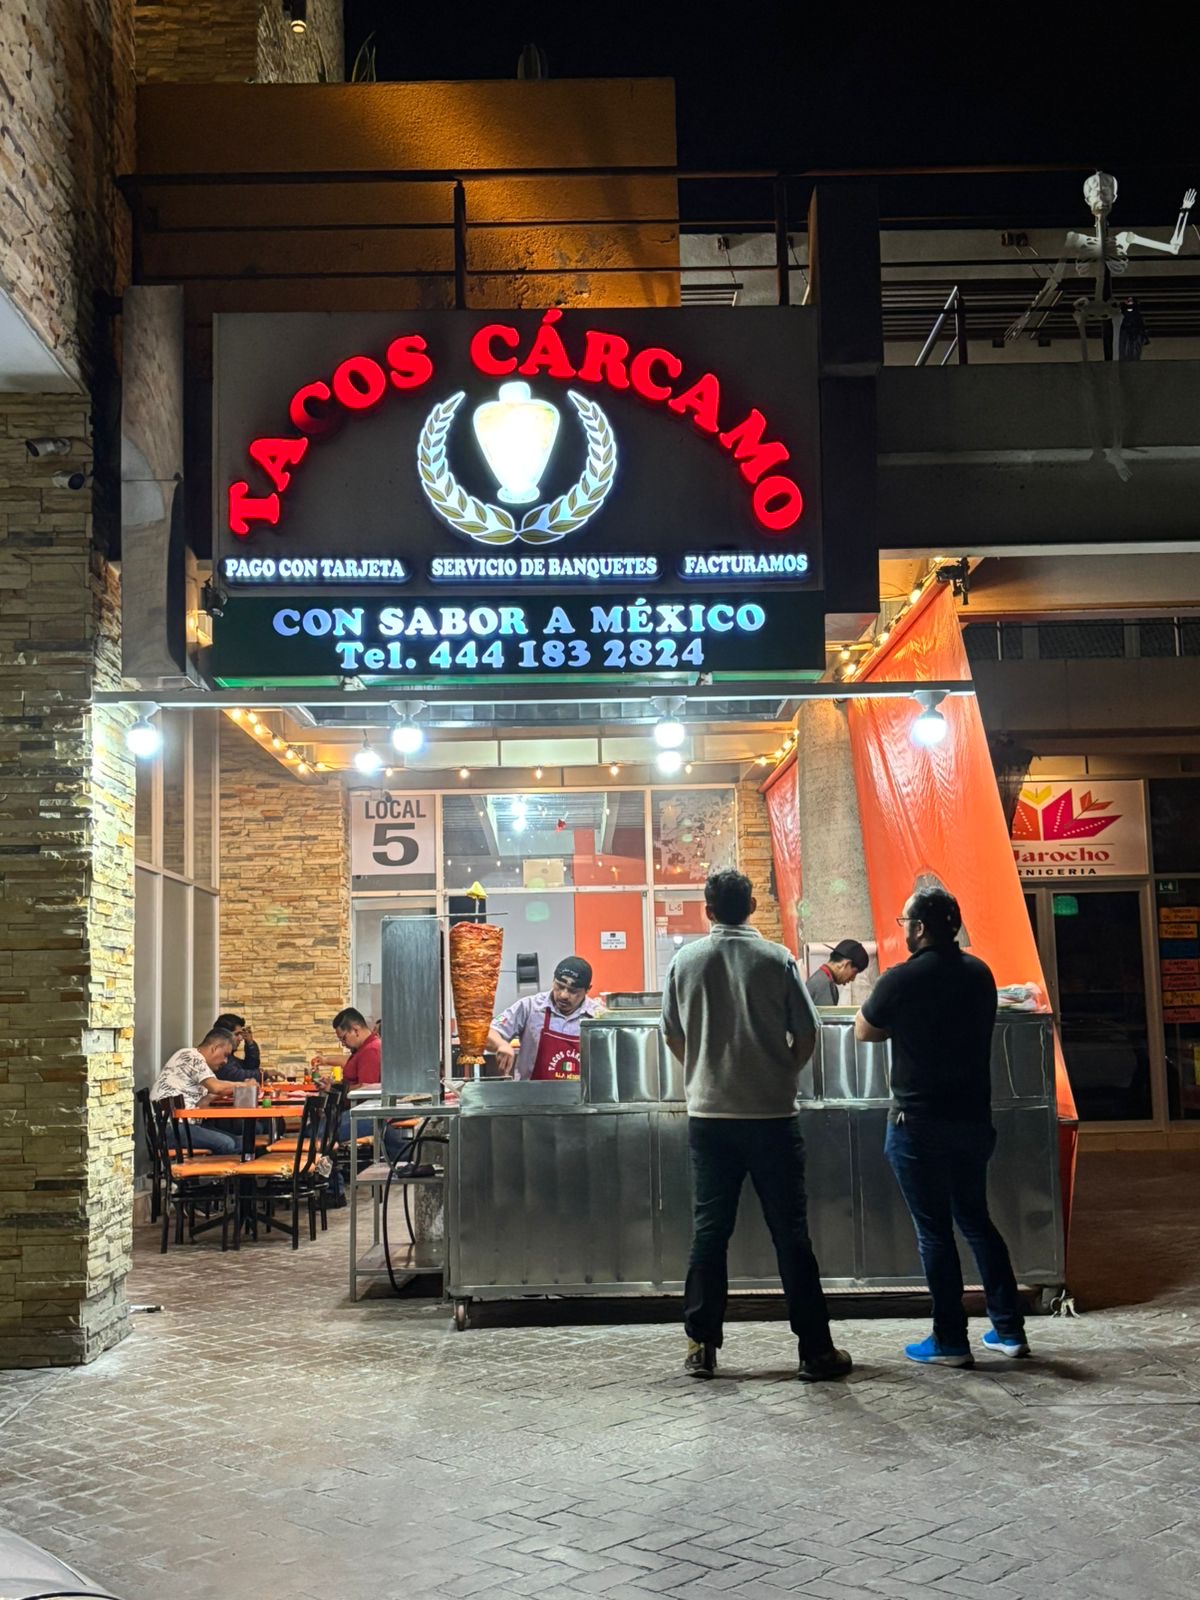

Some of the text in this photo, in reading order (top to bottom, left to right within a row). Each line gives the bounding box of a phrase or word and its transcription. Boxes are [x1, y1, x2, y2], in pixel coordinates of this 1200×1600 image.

[228, 309, 803, 535] TACOS CÁRCAMO
[225, 559, 405, 577] PAGO CON TARJETA
[431, 558, 657, 578] SERVICIO DE BANQUETES
[684, 555, 808, 574] FACTURAMOS
[272, 597, 766, 637] CON SABOR A MÉXICO
[335, 638, 705, 669] Tel. 444 183 2824
[365, 799, 426, 819] LOCAL
[372, 822, 419, 867] 5
[548, 1051, 565, 1071] TACOS
